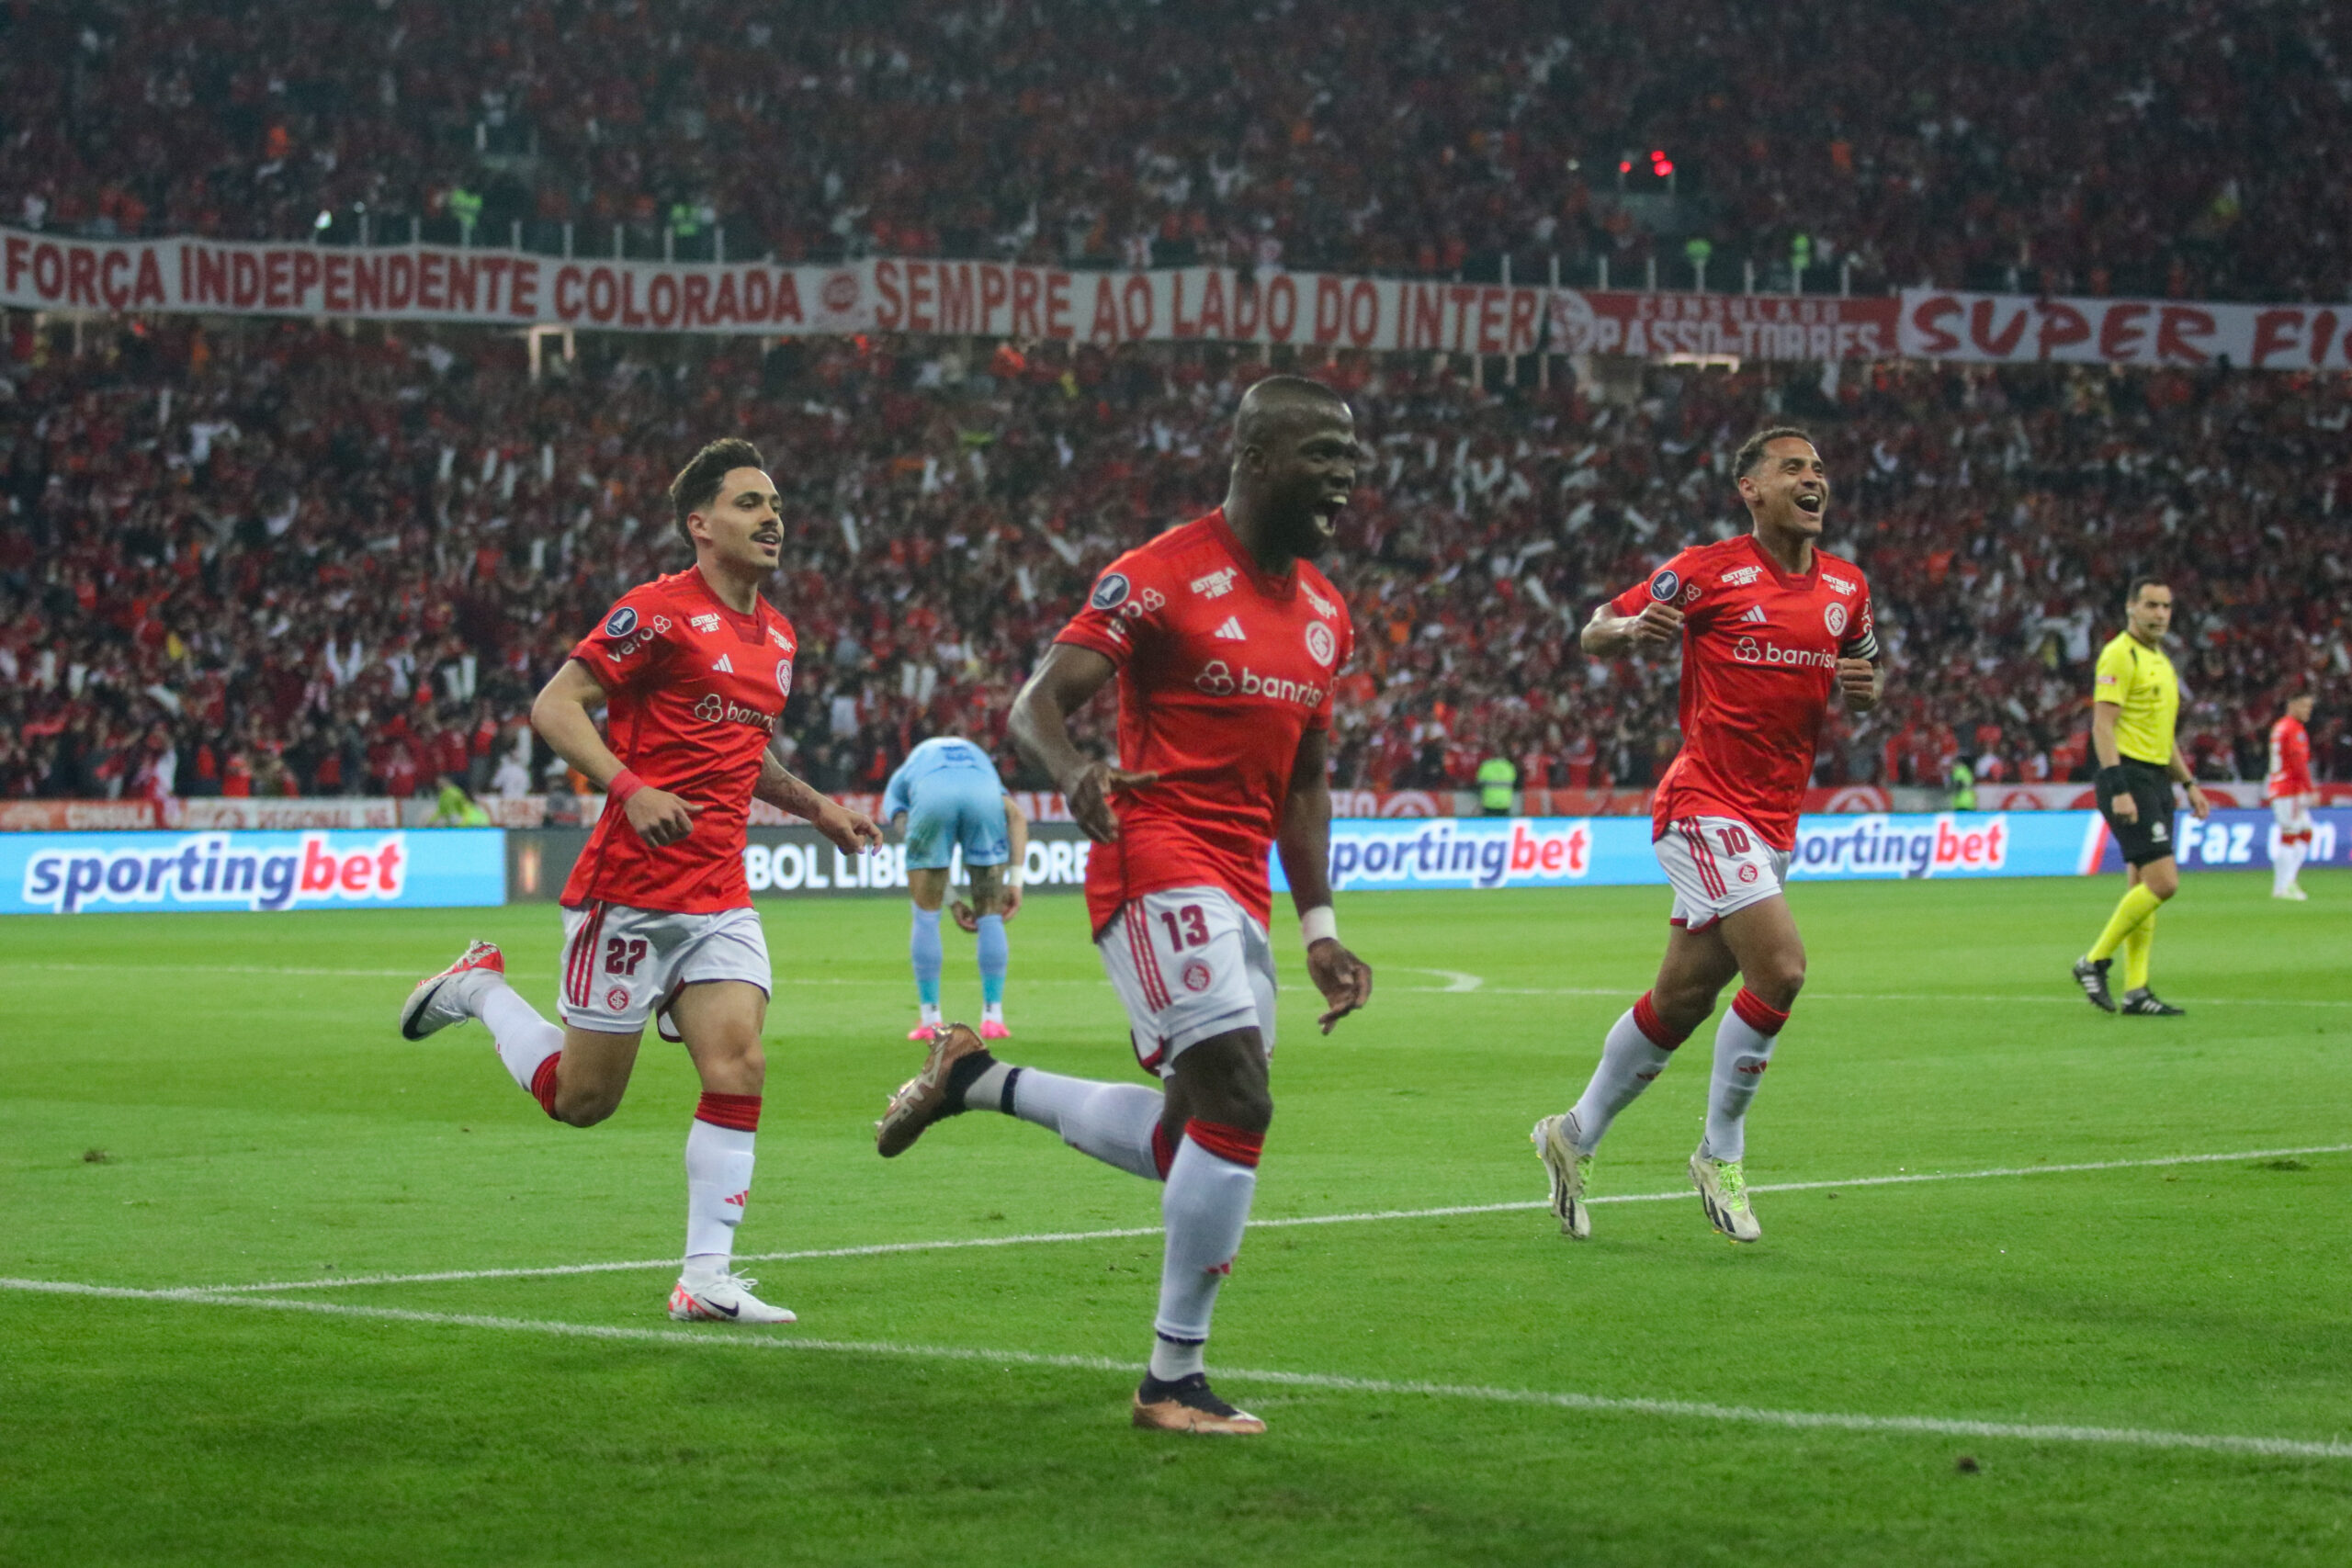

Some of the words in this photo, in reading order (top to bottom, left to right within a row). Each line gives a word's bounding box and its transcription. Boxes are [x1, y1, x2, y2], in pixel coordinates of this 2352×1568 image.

[4, 237, 165, 309] FORÇA
[180, 245, 538, 316] INDEPENDENTE
[554, 265, 803, 327] COLORADA
[874, 261, 1074, 338] SEMPRE
[1090, 277, 1154, 344] AO
[1171, 272, 1296, 341] LADO
[1315, 276, 1378, 348] DO
[1397, 283, 1538, 355] INTER
[1912, 296, 2215, 362] SUPER
[2254, 310, 2352, 364] FI
[1721, 566, 1763, 583] ESTRELA
[1740, 574, 1758, 585] BET
[606, 626, 654, 662] vero
[1332, 826, 1587, 885] portingbet
[1716, 827, 1751, 857] 10
[2176, 814, 2255, 864] Faz
[31, 839, 401, 911] sportingbet
[1160, 904, 1210, 953] 13
